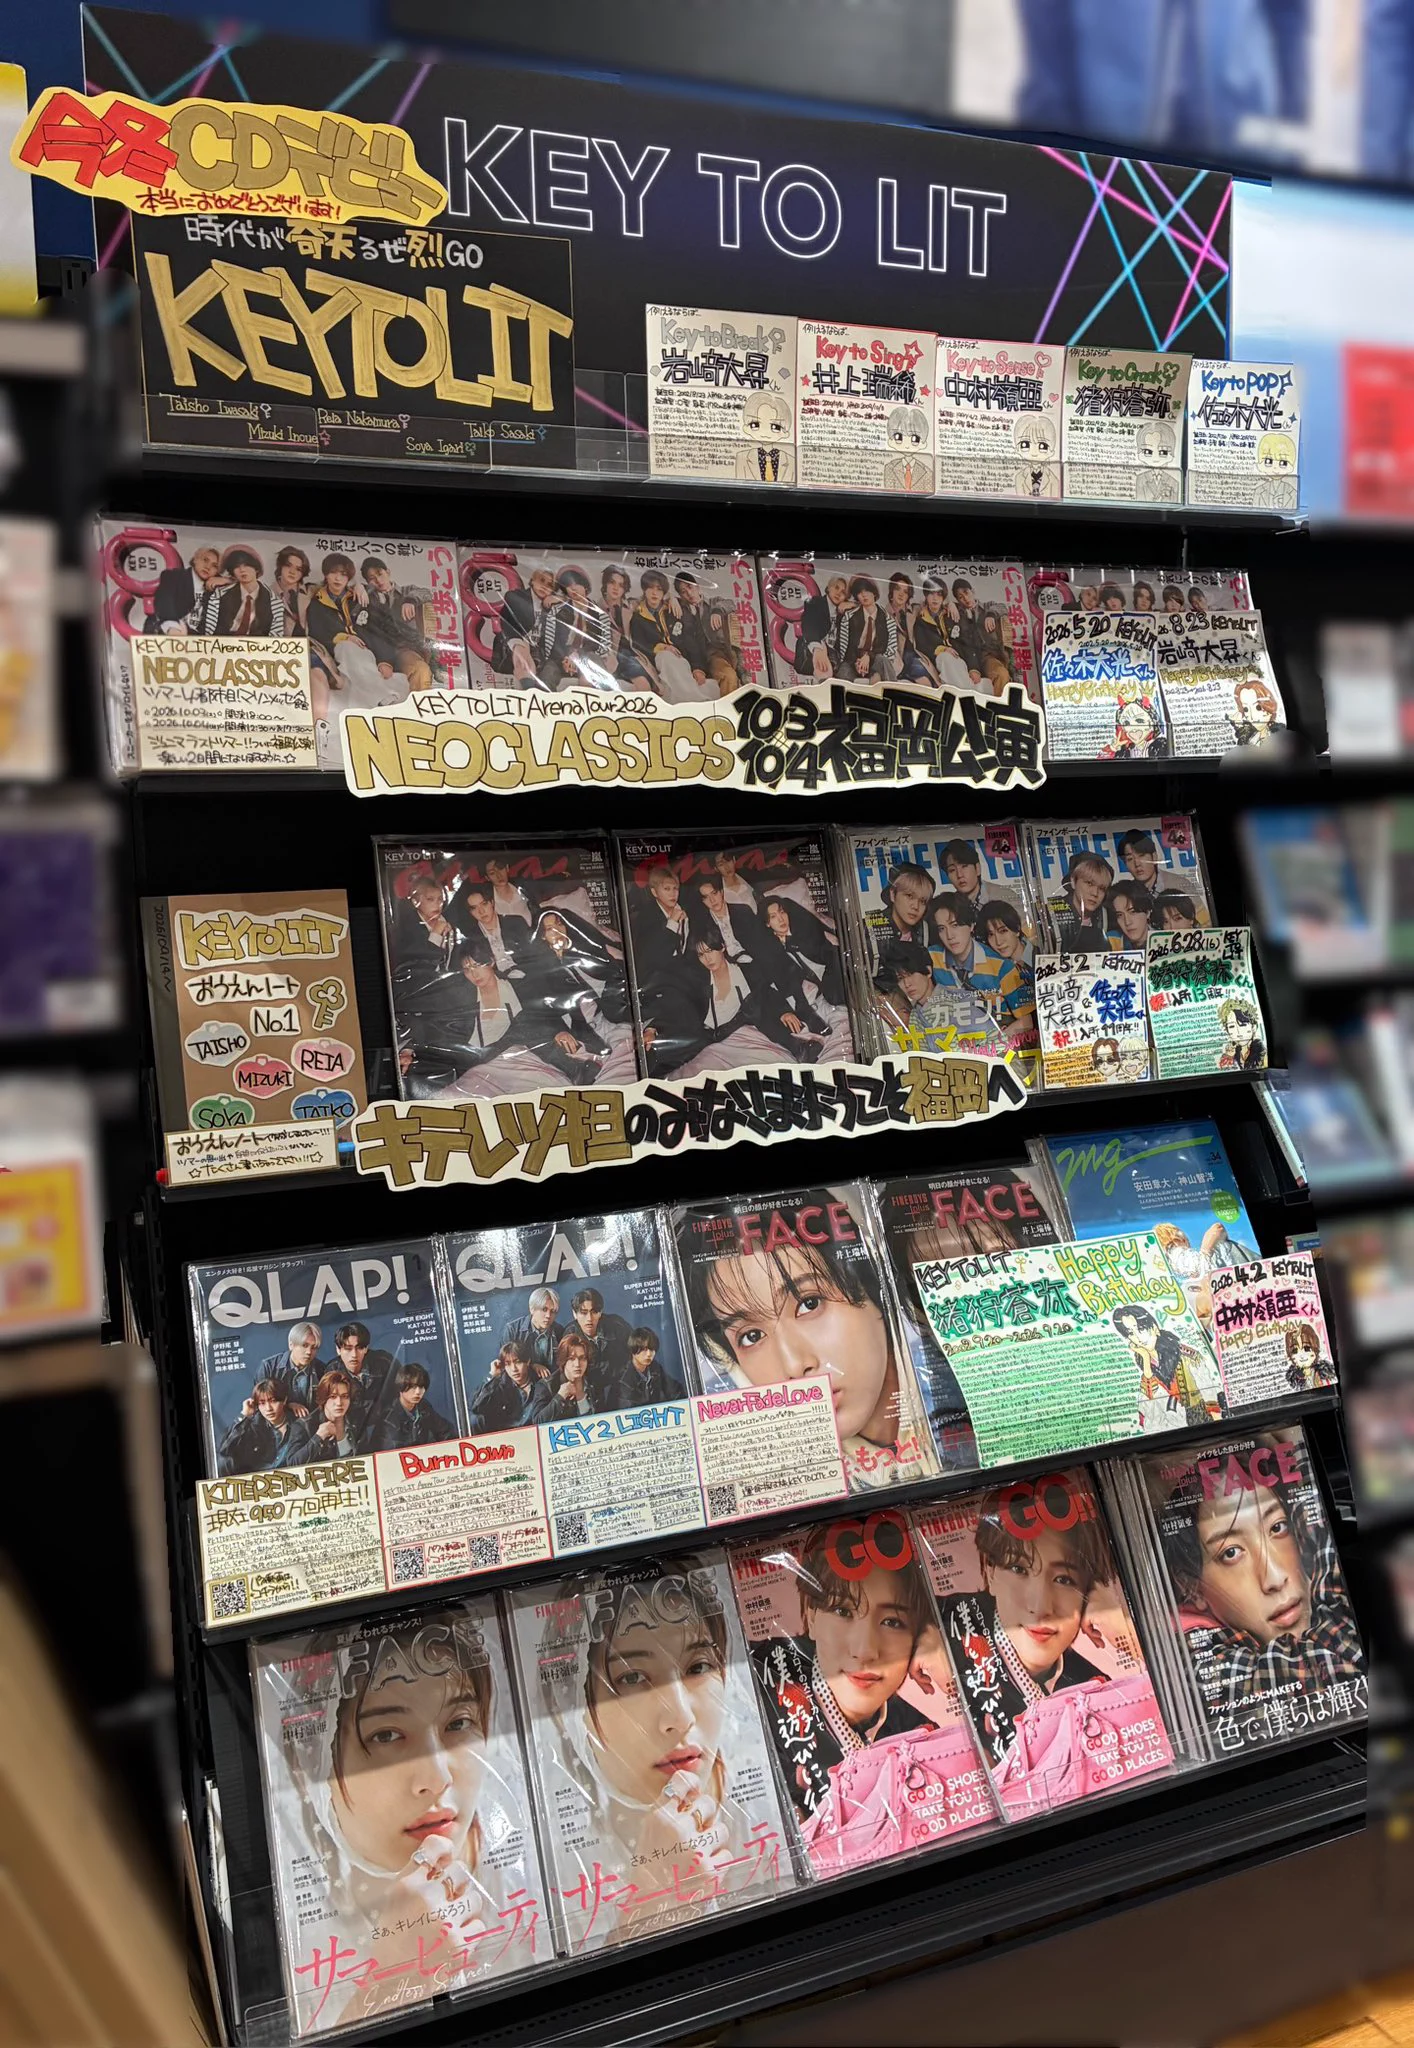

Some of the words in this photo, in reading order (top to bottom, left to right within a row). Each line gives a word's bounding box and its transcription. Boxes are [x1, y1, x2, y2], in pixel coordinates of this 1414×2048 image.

[20, 93, 443, 220] 今冬CDデビュー
[444, 117, 671, 238] KEY
[698, 153, 842, 259] TO
[878, 177, 1007, 277] LIT
[144, 251, 574, 411] KEYTOLIT
[815, 335, 848, 365] Key
[848, 342, 868, 361] to
[159, 393, 210, 413] Taisho
[248, 422, 285, 442] Mizuki
[286, 425, 319, 444] Inoue
[405, 436, 434, 455] Soya
[127, 554, 137, 572] KEY
[139, 556, 147, 570] TO
[272, 640, 304, 654] 2026
[527, 694, 584, 717] Arena
[582, 693, 618, 714] Tour
[615, 696, 658, 716] 2026
[816, 684, 1042, 789] 福岡公演
[345, 715, 737, 790] NEOCLASSICS
[854, 836, 911, 848] ファインボーイズ
[1035, 825, 1089, 837] ファインボーイズ
[384, 852, 407, 862] KEY
[407, 851, 421, 861] TO
[625, 845, 643, 856] KEY
[644, 845, 658, 854] TO
[658, 844, 672, 854] LIT
[1041, 847, 1057, 856] KEY
[1057, 847, 1067, 855] TO
[254, 1008, 300, 1034] No.1
[931, 998, 1003, 1028] カモン!
[188, 1035, 248, 1061] TAISHO
[300, 1049, 345, 1072] REIA
[238, 1070, 294, 1088] MIZUKI
[198, 1108, 248, 1130] SOYA
[294, 1102, 355, 1119] TAIKO
[891, 1192, 928, 1206] FINEBOYS
[931, 1182, 1040, 1229] FACE
[691, 1217, 733, 1234] FINEBOYS
[736, 1202, 857, 1256] FACE
[1053, 1237, 1138, 1285] Happy
[208, 1254, 410, 1329] QLAP!
[623, 1282, 642, 1292] SUPER
[643, 1279, 663, 1289] EIGHT
[1077, 1268, 1188, 1317] Birthday
[1210, 1262, 1268, 1295] 2026.4.2
[393, 1316, 415, 1326] SUPER
[414, 1313, 435, 1323] EIGHT
[631, 1302, 645, 1310] King
[649, 1299, 666, 1308] Prince
[400, 1338, 414, 1346] King
[419, 1334, 438, 1343] Prince
[1219, 1329, 1254, 1351] Happy
[1255, 1319, 1303, 1339] Birthday
[548, 1421, 602, 1452] KEY
[596, 1420, 615, 1440] 2
[616, 1406, 686, 1435] LIGHT
[400, 1450, 459, 1480] Burn
[458, 1441, 516, 1467] Down
[1197, 1440, 1303, 1501] FACE
[584, 1566, 725, 1644] FACE
[337, 1615, 491, 1700] FACE
[1085, 1729, 1118, 1752] GOOD
[1118, 1718, 1156, 1739] SHOES
[1094, 1749, 1122, 1766] TAKE
[1121, 1740, 1148, 1758] YOU
[1146, 1733, 1162, 1749] TO
[907, 1782, 944, 1804] GOOD
[946, 1769, 985, 1791] SHOES
[1091, 1762, 1124, 1784] GOOD
[913, 1801, 945, 1819] TAKE
[945, 1793, 973, 1810] YOU
[975, 1785, 992, 1800] TO
[910, 1819, 947, 1840] GOOD
[629, 1833, 720, 1867] さぁ、キレイになろう!
[370, 1900, 472, 1940] さぁ、キレイになろう!
[294, 1888, 540, 2032] サマービューティ
[363, 1983, 424, 2017] Endless
